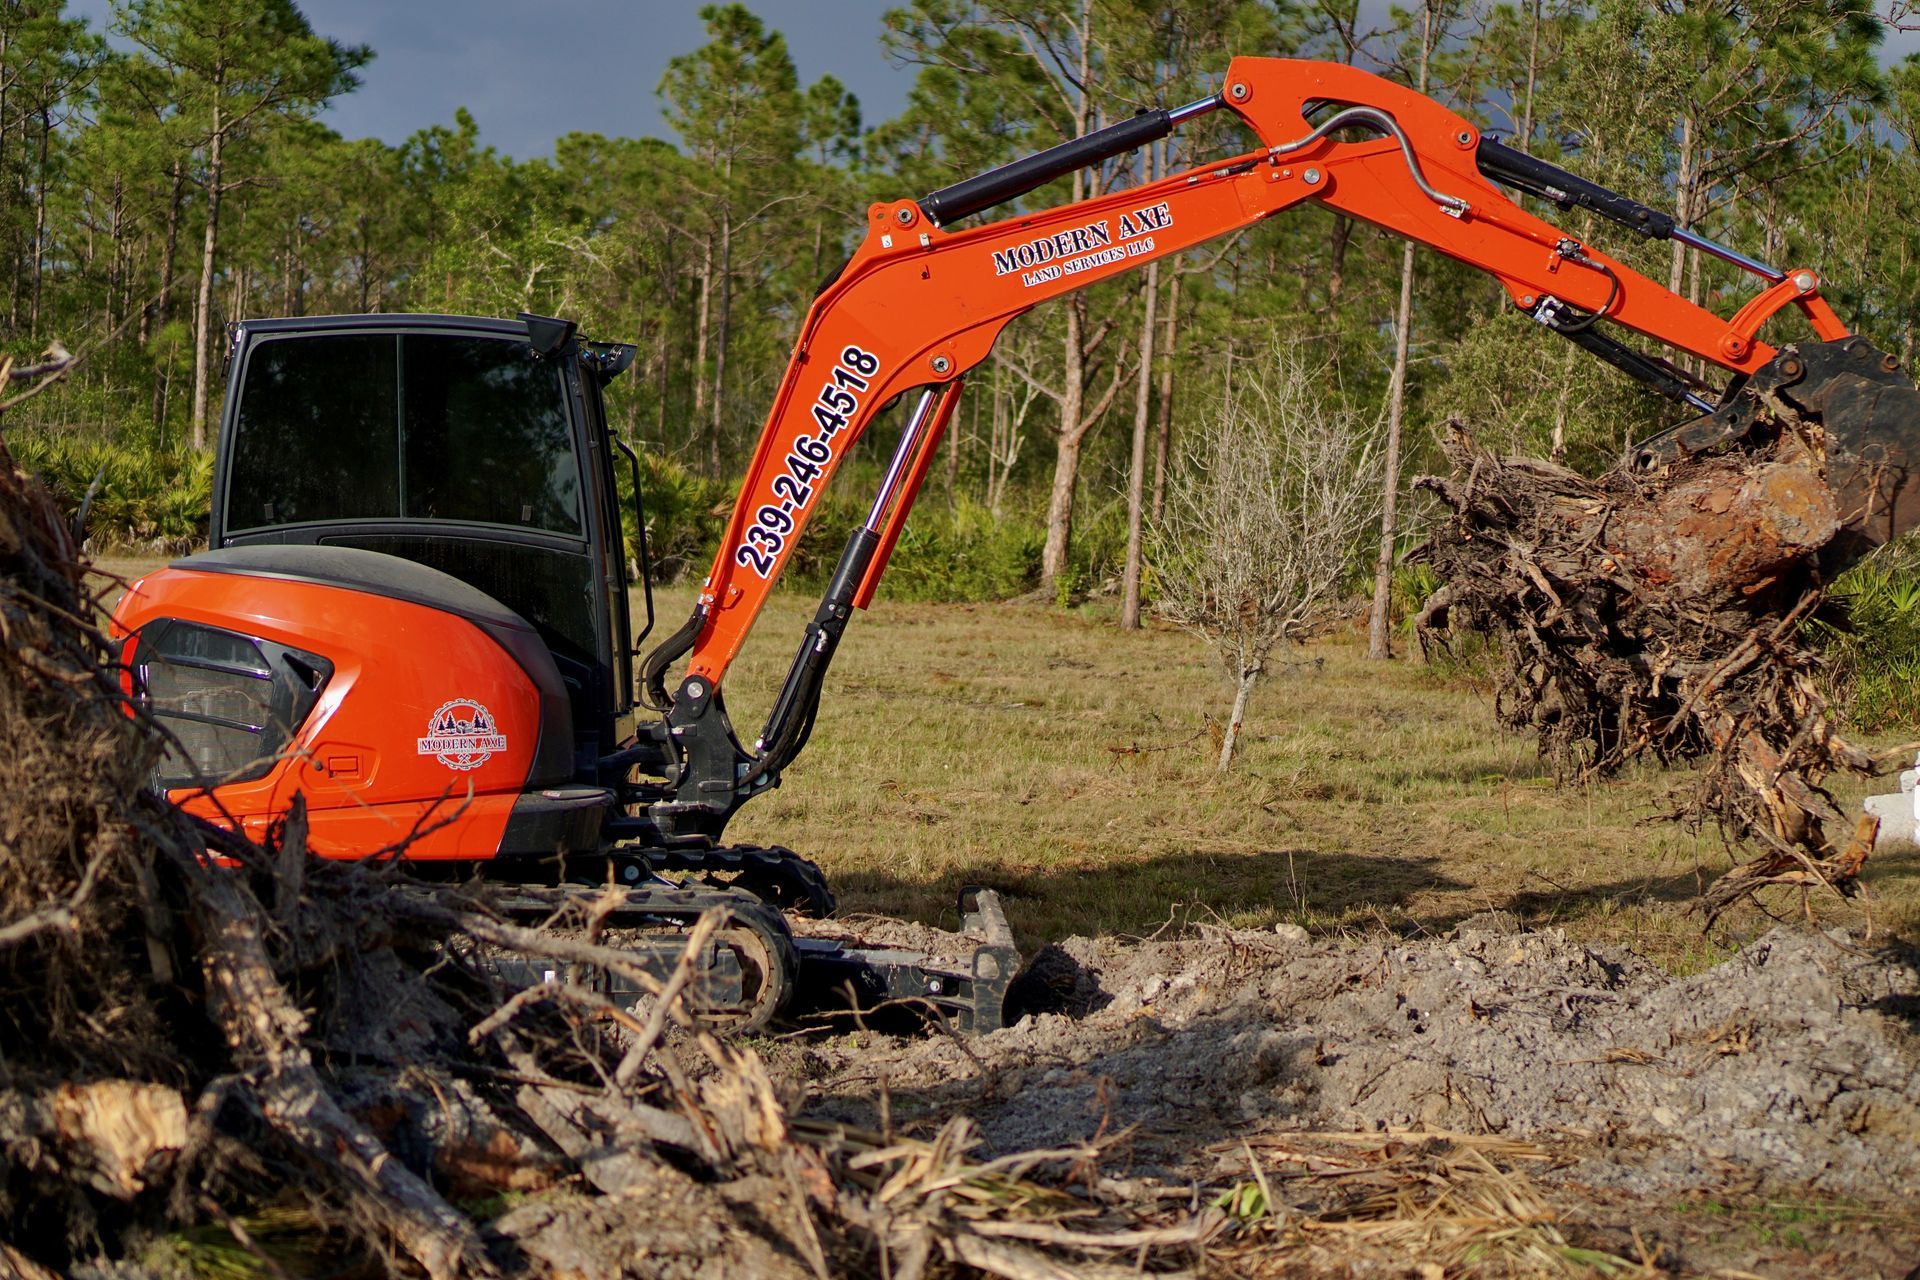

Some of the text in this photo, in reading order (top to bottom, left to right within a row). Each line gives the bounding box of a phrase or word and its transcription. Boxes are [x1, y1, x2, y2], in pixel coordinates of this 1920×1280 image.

[993, 202, 1172, 275] MODERN AXE
[1022, 237, 1154, 287] LAND SERVICES LLC
[736, 345, 879, 578] 239-246-4518
[421, 736, 504, 750] MODERN AXE
